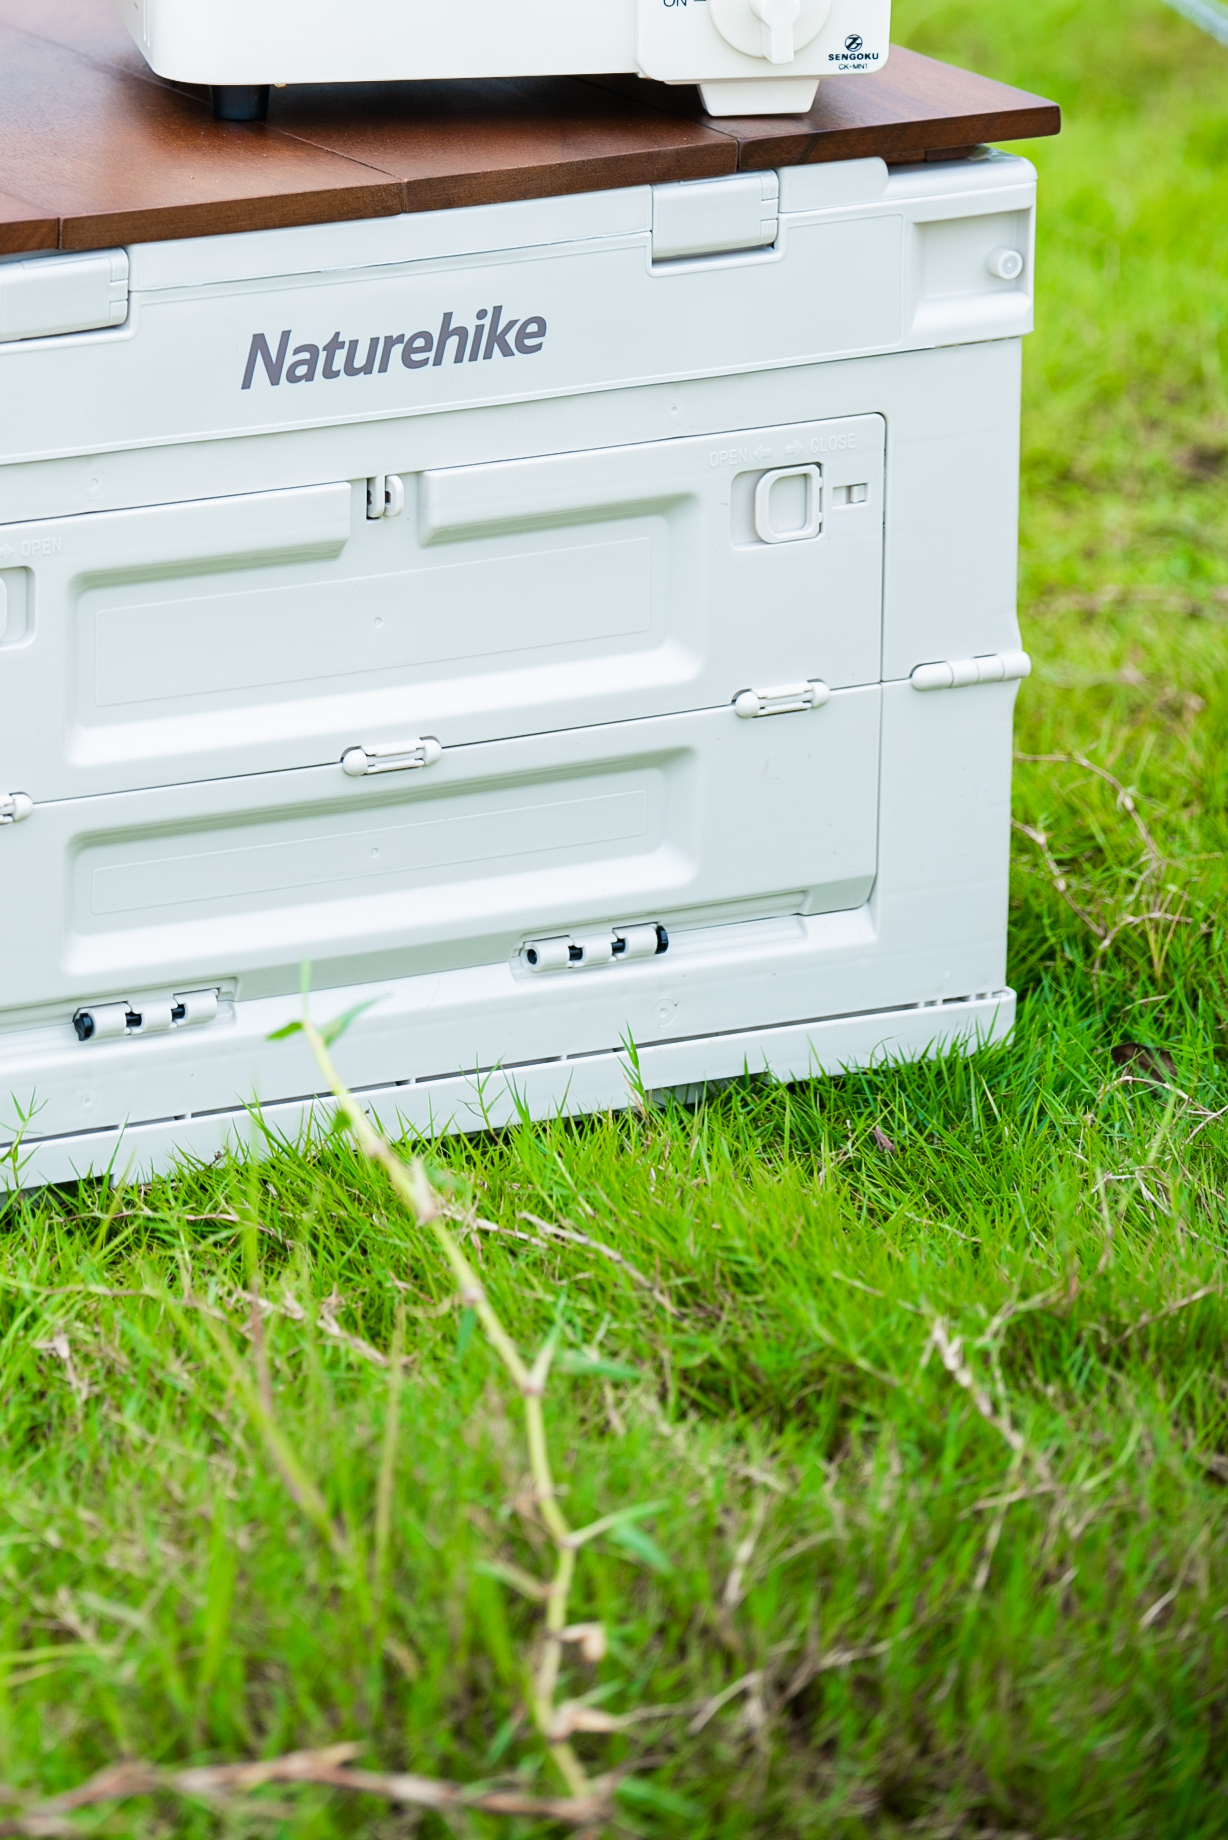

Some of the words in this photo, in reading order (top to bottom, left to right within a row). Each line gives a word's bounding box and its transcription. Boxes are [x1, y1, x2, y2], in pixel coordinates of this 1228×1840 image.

[828, 52, 879, 62] SENGOKU
[838, 62, 868, 71] CK-MN1
[240, 304, 548, 391] Naturehike
[708, 447, 749, 468] OPEN
[809, 432, 857, 455] CLOSE
[20, 536, 63, 558] OPEN
